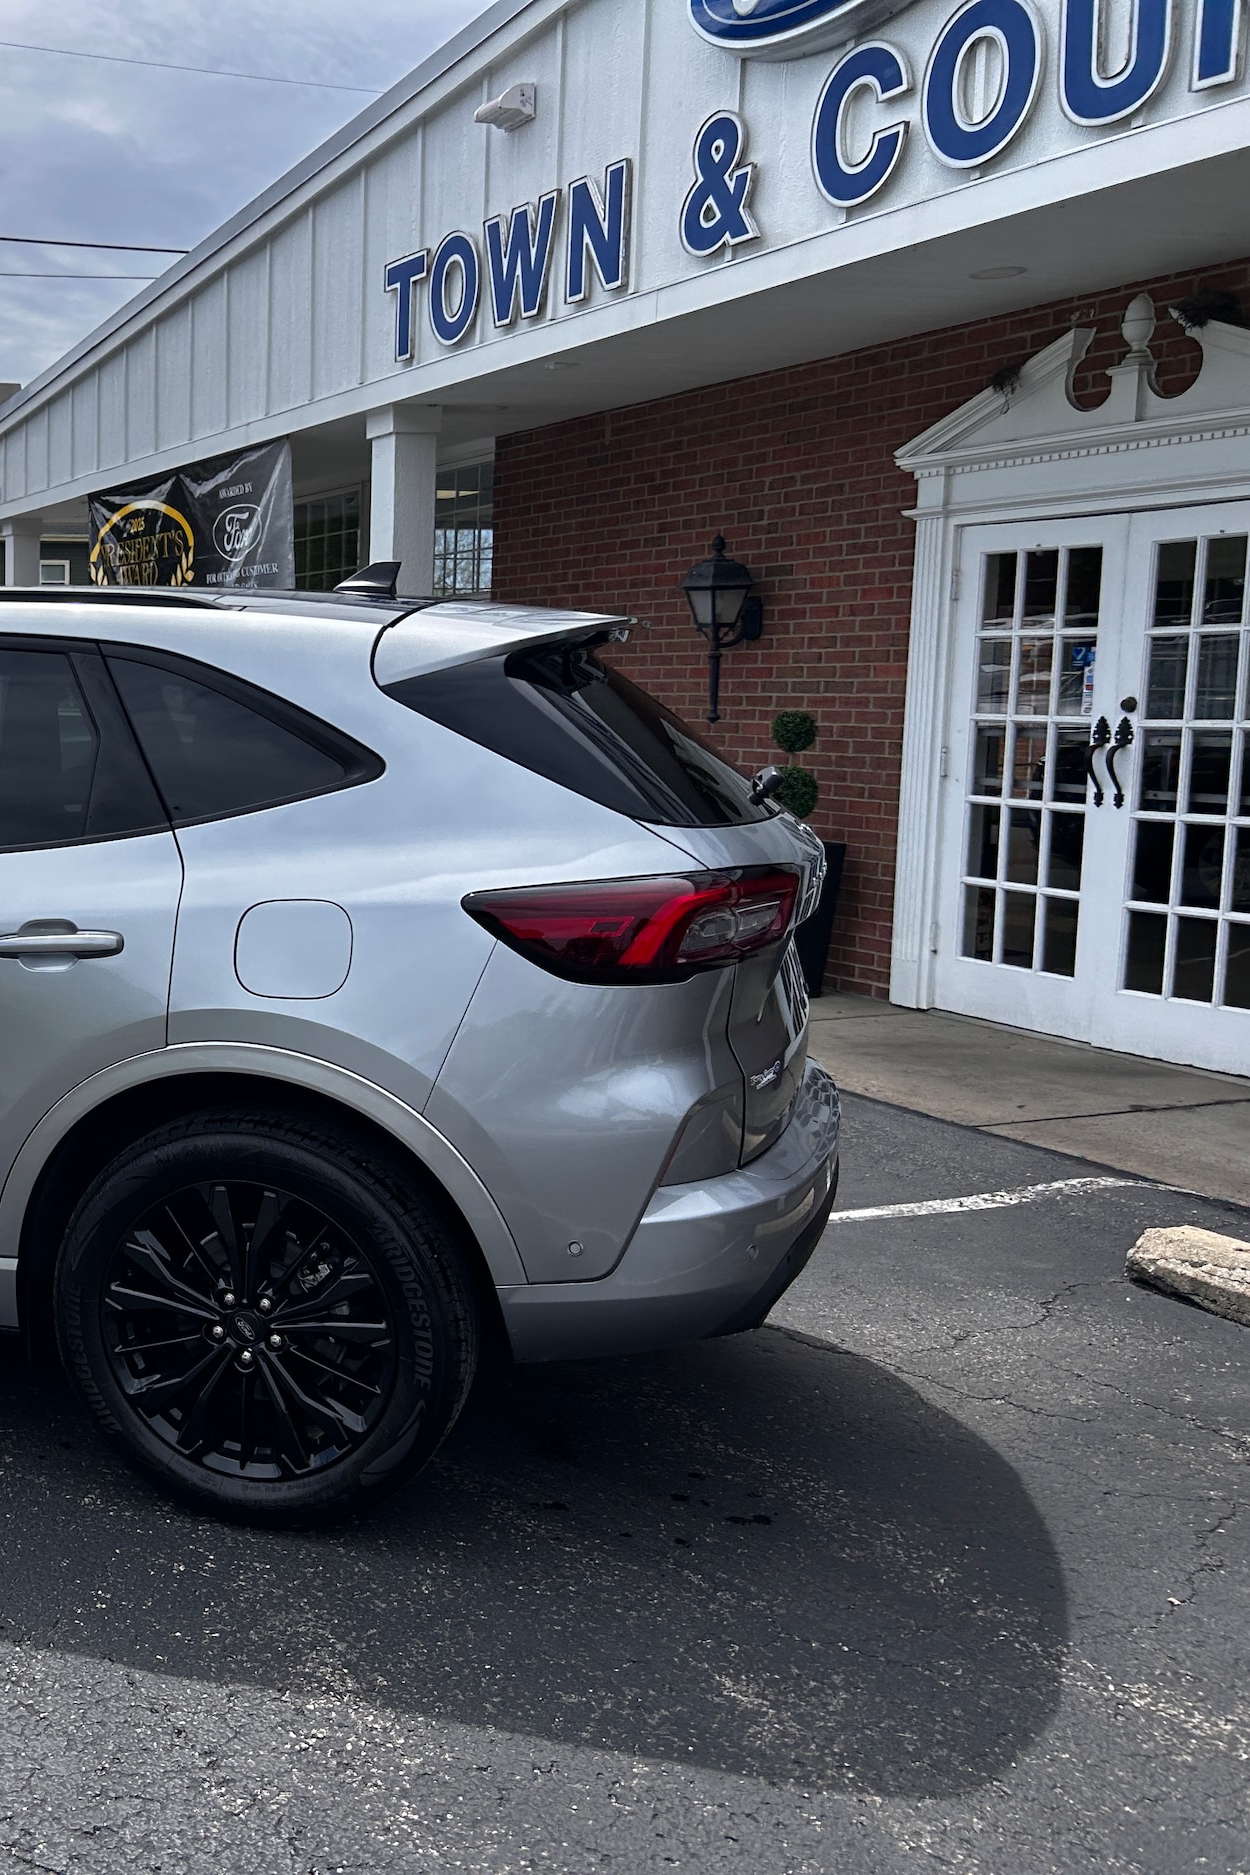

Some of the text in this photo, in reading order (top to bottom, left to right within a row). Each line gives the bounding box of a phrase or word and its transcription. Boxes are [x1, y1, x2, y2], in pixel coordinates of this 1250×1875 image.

[384, 158, 632, 363] TOWN
[680, 109, 759, 258] &
[244, 481, 253, 493] BY
[366, 1221, 435, 1392] BRIDGESTONE
